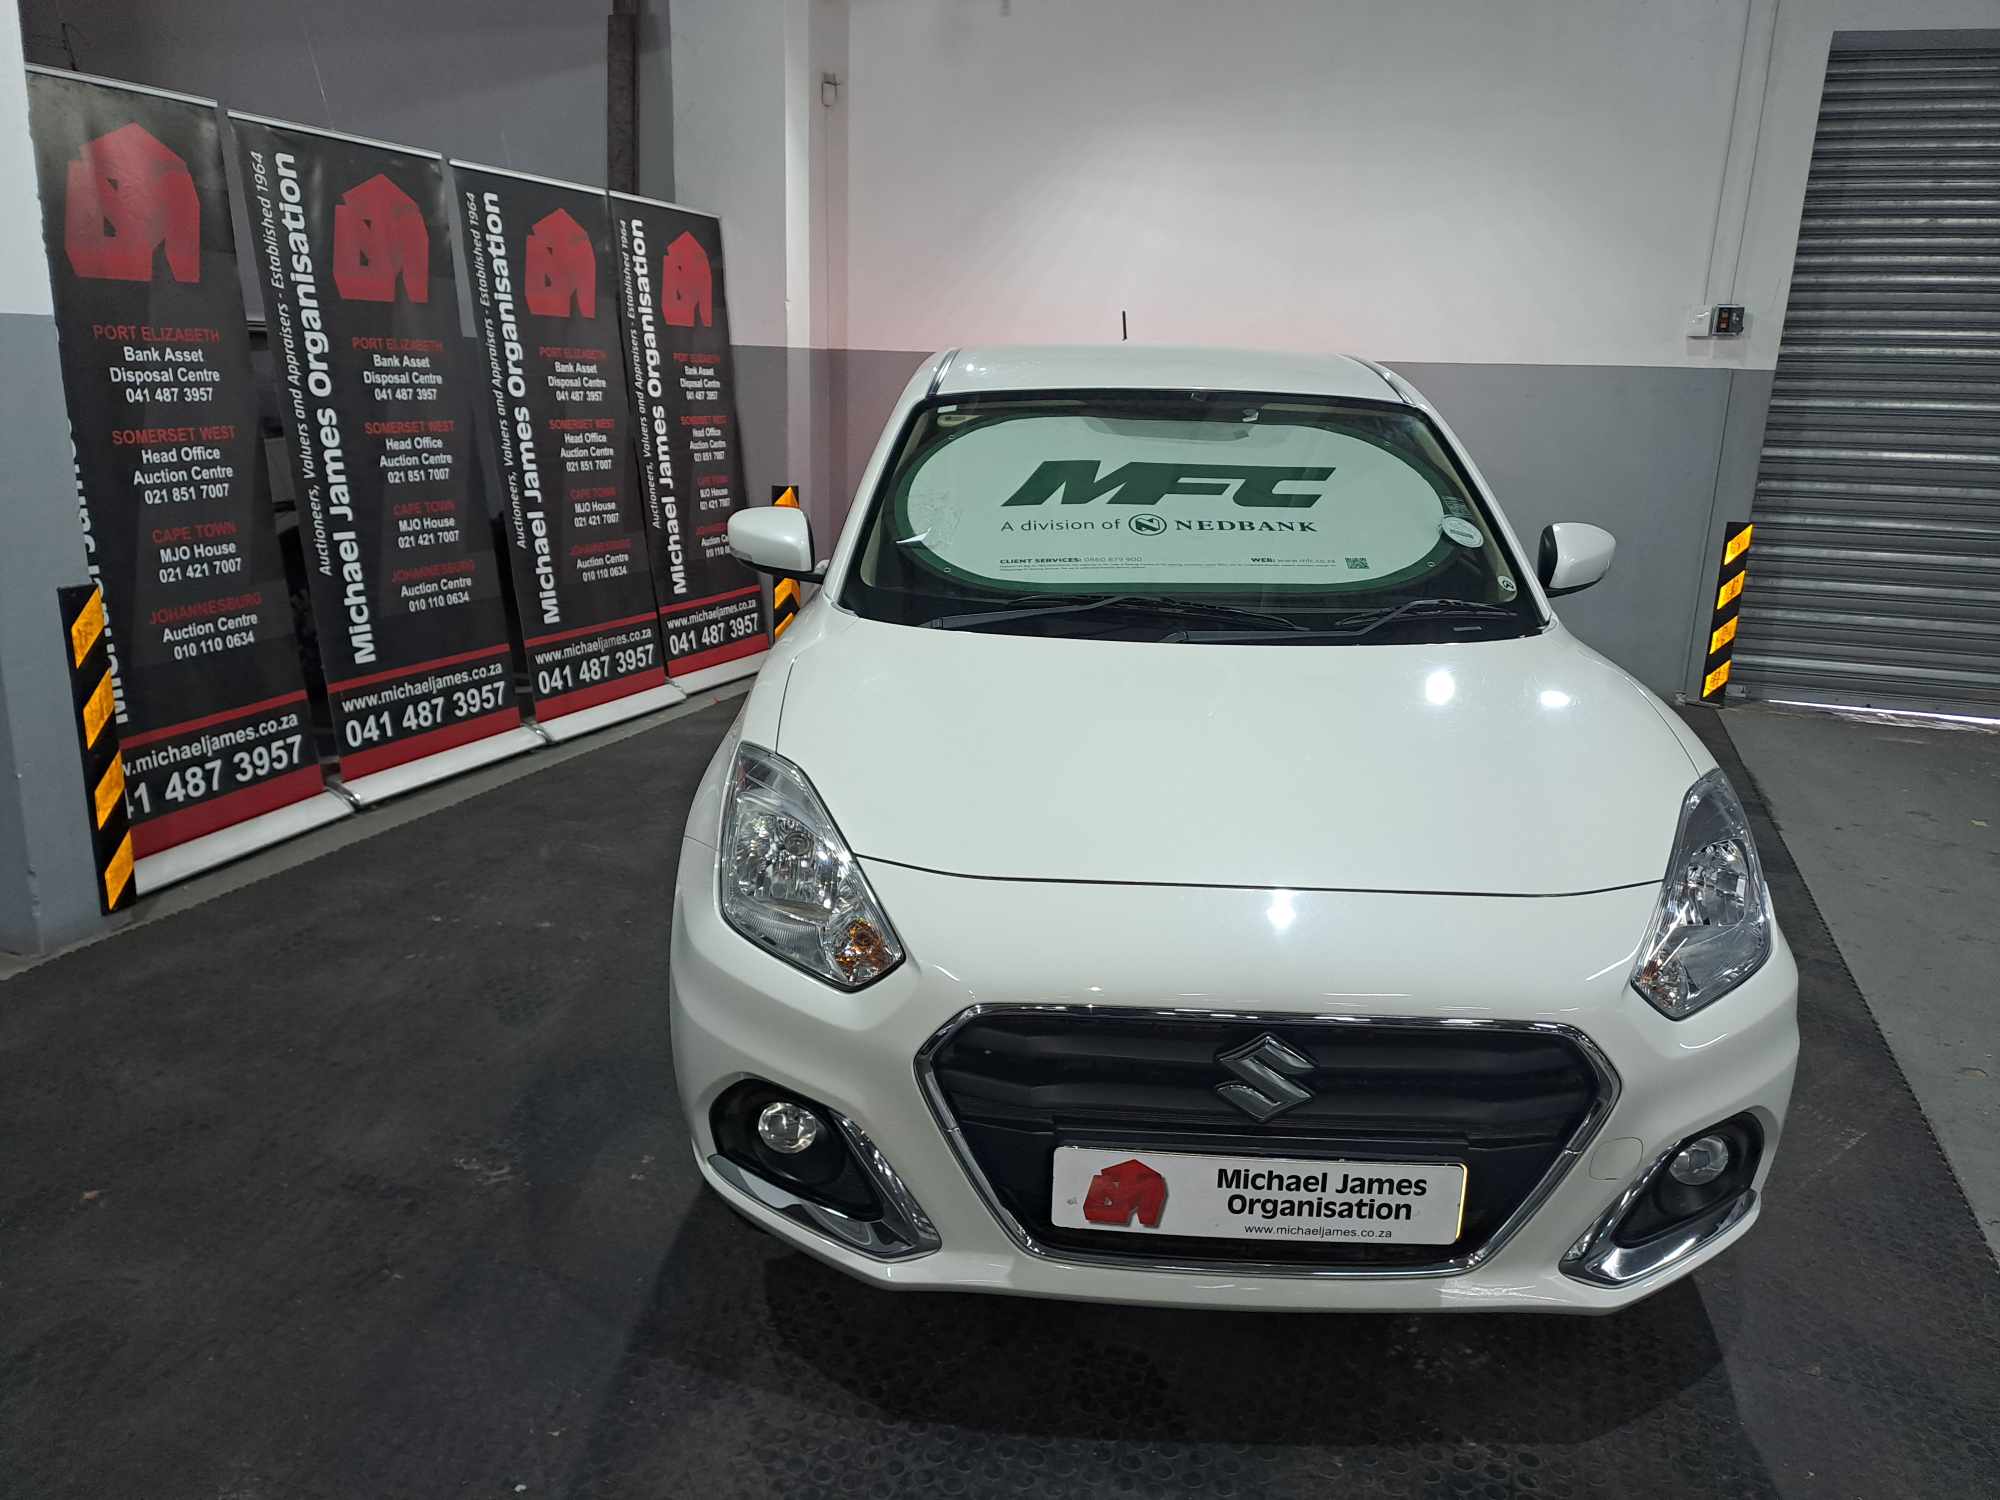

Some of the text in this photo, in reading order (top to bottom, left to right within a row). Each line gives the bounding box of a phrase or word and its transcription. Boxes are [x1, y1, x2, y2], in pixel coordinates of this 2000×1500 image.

[92, 325, 220, 343] PORT ELIZABETH
[124, 346, 204, 362] Bank Asset
[250, 150, 332, 576] Auctioneers, Valuers and Appraisers Established 1964
[373, 354, 431, 368] Bank Asset
[109, 366, 221, 386] Disposal Centre
[363, 371, 443, 386] Disposal Centre
[465, 192, 527, 549] Auctioneers, Valuers and Appraisers Established 1964
[126, 387, 213, 402] 041 487 3957
[375, 388, 437, 400] 041 487 3957
[275, 152, 376, 664] Michael James Organisation
[484, 192, 560, 624] Michael James Organisation
[631, 219, 687, 595] Michael James Organisation
[112, 425, 235, 444] SOMERSET WEST
[386, 436, 443, 450] Head Office
[141, 446, 220, 464] Head Office
[380, 453, 452, 467] Auction Centre
[560, 447, 589, 458] Auction
[134, 465, 233, 485] Auction Centre
[388, 468, 450, 483] 021 851 7007
[1000, 459, 1336, 508] MFC
[145, 484, 230, 504] 021 851 7007
[399, 517, 455, 532] MJO House
[1001, 517, 1318, 532] A division of NEDBANK
[153, 527, 192, 544] CAPE
[398, 530, 459, 549] 021 421 7007
[160, 543, 236, 563] MJO House
[576, 556, 604, 569] Auction
[159, 557, 242, 583] 021 421 7007
[401, 577, 472, 597] Auction Centre
[409, 591, 469, 612] 010 110 0634
[163, 614, 258, 642] Auction Centre
[669, 613, 758, 655] 041 487 3957
[174, 630, 255, 660] 010 110 0634
[535, 628, 652, 664] www.michaeljames.co.za
[538, 643, 654, 694] 041 487 3957
[342, 663, 503, 713] www.michaeljames.co.za
[346, 681, 505, 748] 041 487 3957
[164, 759, 222, 802] 487
[233, 734, 302, 782] 3957
[1216, 1168, 1427, 1197] Michael James
[1227, 1193, 1412, 1221] Organisation
[1244, 1224, 1393, 1240] www.michaeljames.co.za
